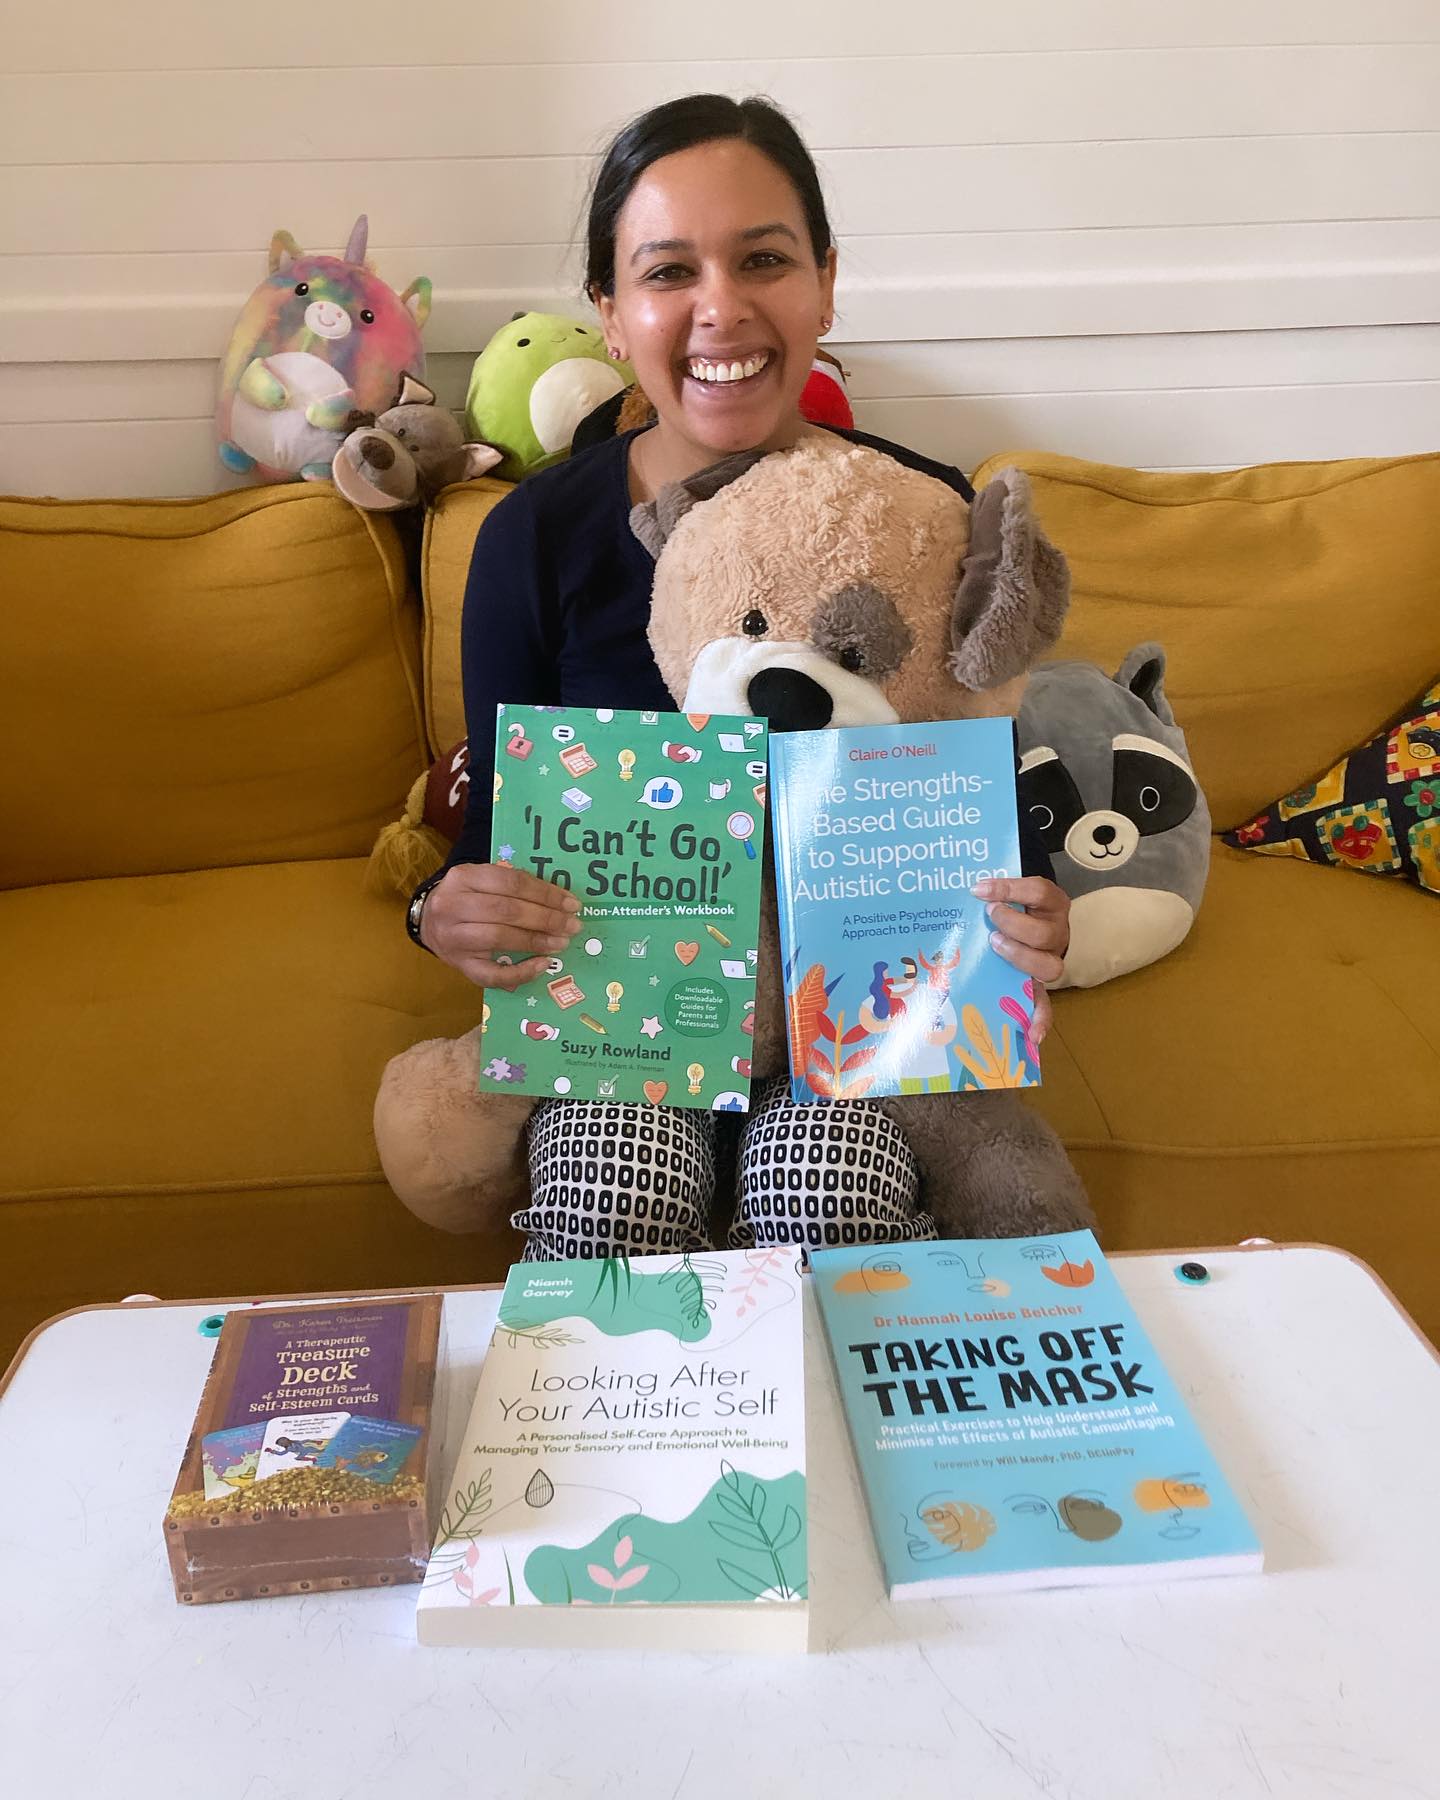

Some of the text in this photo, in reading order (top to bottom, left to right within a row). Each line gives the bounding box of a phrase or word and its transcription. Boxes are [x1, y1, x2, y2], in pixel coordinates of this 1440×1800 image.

[848, 744, 937, 761] Claire O'Neill
[854, 771, 992, 802] Strengths-
[814, 802, 982, 837] Based Guide
[558, 817, 656, 858] Can't
[670, 823, 720, 862] Go
[807, 835, 989, 870] to Supporting
[530, 856, 571, 890] To
[793, 873, 891, 902] Autistic
[584, 904, 672, 917] Non-Attender's
[674, 904, 735, 916] Workbook
[843, 907, 964, 926] A Positive Psychology
[842, 924, 896, 940] Approach
[898, 925, 910, 934] to
[674, 994, 724, 1004] Downloadable
[685, 986, 714, 994] Includes
[678, 1010, 703, 1019] Parents
[680, 1002, 704, 1010] Guides
[675, 1019, 720, 1029] Professionals
[560, 1040, 672, 1061] Suzy Rowland
[528, 1278, 573, 1287] Niamh
[522, 1288, 574, 1298] Garvey
[873, 1304, 1084, 1328] Dr Hannah Louise Belcher
[285, 1335, 366, 1349] A Therapeutic
[848, 1323, 1125, 1374] TAKING OFF
[276, 1346, 371, 1364] Treasure
[280, 1361, 358, 1386] Deck
[530, 1361, 750, 1396] Looking After
[276, 1384, 348, 1399] Strengths
[862, 1361, 1154, 1417] THE MASK
[249, 1392, 380, 1412] Self-Esteem Cards
[498, 1387, 779, 1422] Your Autistic Self
[880, 1402, 1159, 1437] Practical Exercises to Help Understand and
[516, 1427, 748, 1442] A Personalised Self-Care Approach to
[874, 1413, 1176, 1451] Minimise the Effects of Autistic Camouflaging
[474, 1438, 789, 1456] Managing Your Sensory and Emotional Well-Being
